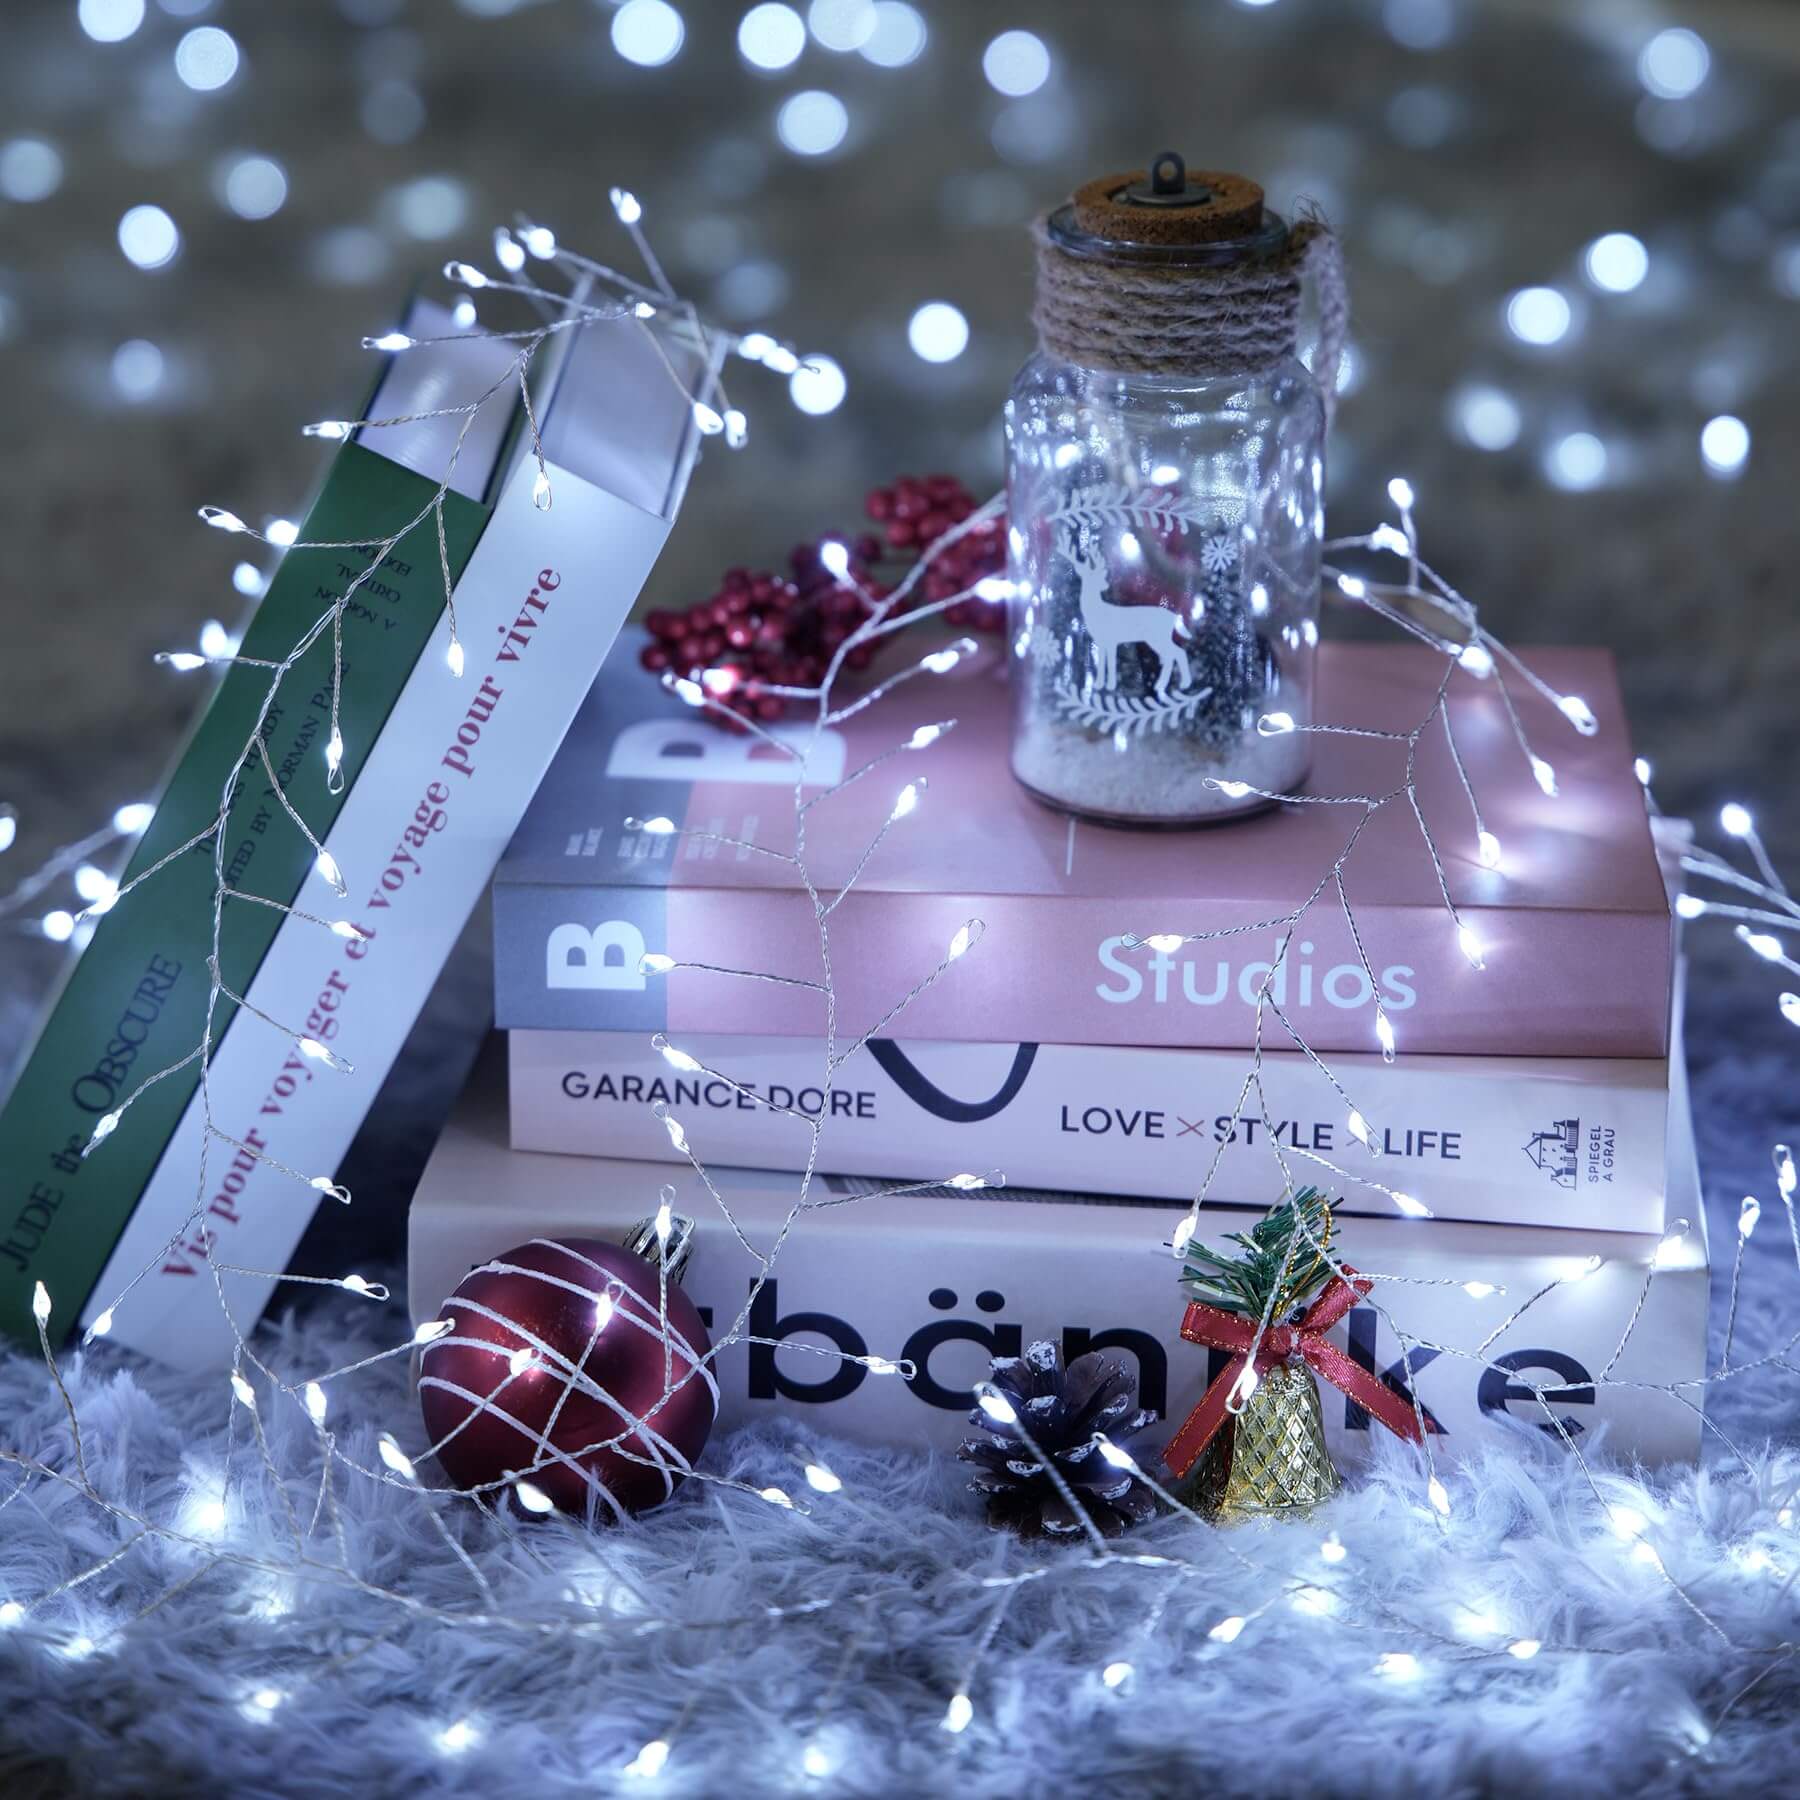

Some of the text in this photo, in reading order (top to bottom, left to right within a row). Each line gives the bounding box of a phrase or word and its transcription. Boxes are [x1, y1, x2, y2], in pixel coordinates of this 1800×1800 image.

[251, 807, 272, 836] BY
[208, 1127, 268, 1225] pour
[260, 969, 349, 1118] voyger
[367, 781, 450, 910] voyage
[441, 675, 503, 778] pour
[495, 567, 561, 664] vivre
[547, 920, 646, 991] B
[1095, 934, 1417, 1010] Studios
[561, 1071, 877, 1119] GARANCE DORE
[1061, 1105, 1165, 1138] LOVE
[1213, 1115, 1334, 1151] STYLE
[1384, 1127, 1462, 1161] LIFE
[1588, 1125, 1602, 1183] SPIEGEL
[1603, 1128, 1616, 1168] GRAU
[2, 1181, 65, 1273] JUDE
